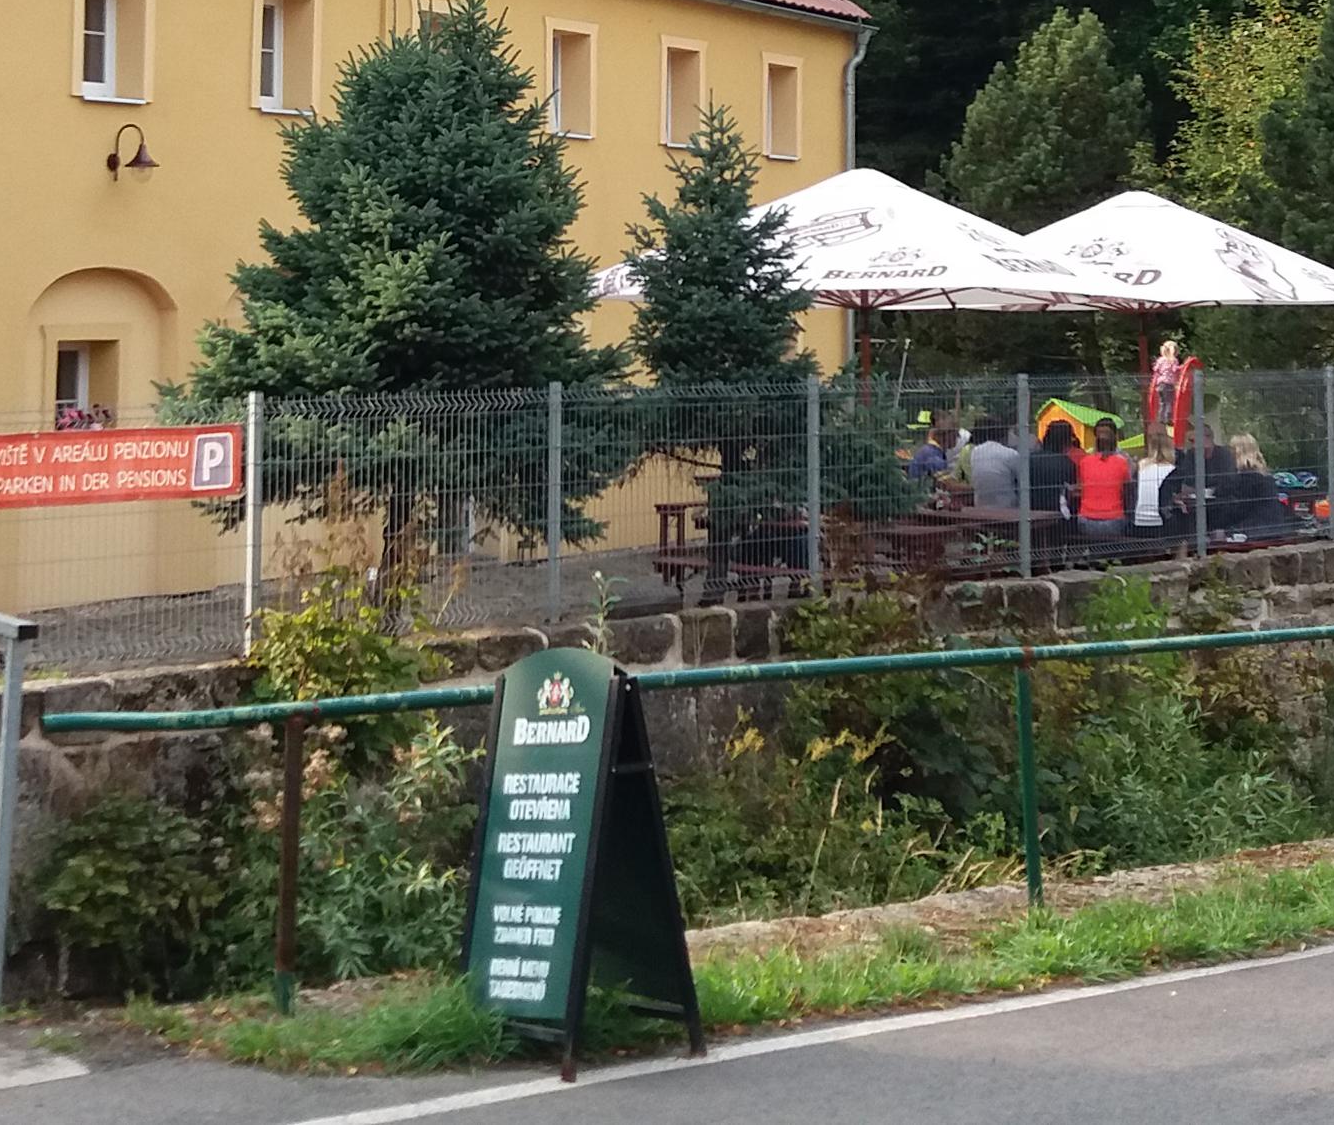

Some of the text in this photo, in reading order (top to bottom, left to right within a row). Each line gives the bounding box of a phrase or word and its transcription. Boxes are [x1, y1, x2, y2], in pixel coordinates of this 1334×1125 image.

[821, 265, 949, 280] BERNARD
[33, 446, 46, 464] V
[51, 441, 109, 463] AREÁLU
[113, 440, 190, 460] PENZIONU
[202, 441, 225, 482] P
[59, 474, 77, 493] IN
[82, 473, 110, 492] DER
[117, 469, 188, 489] PENSIONS
[513, 715, 591, 746] BERNARD
[503, 772, 582, 795] RESTAURACE
[496, 832, 577, 854] RESTAURANT
[503, 855, 564, 881] GEÖFFNET
